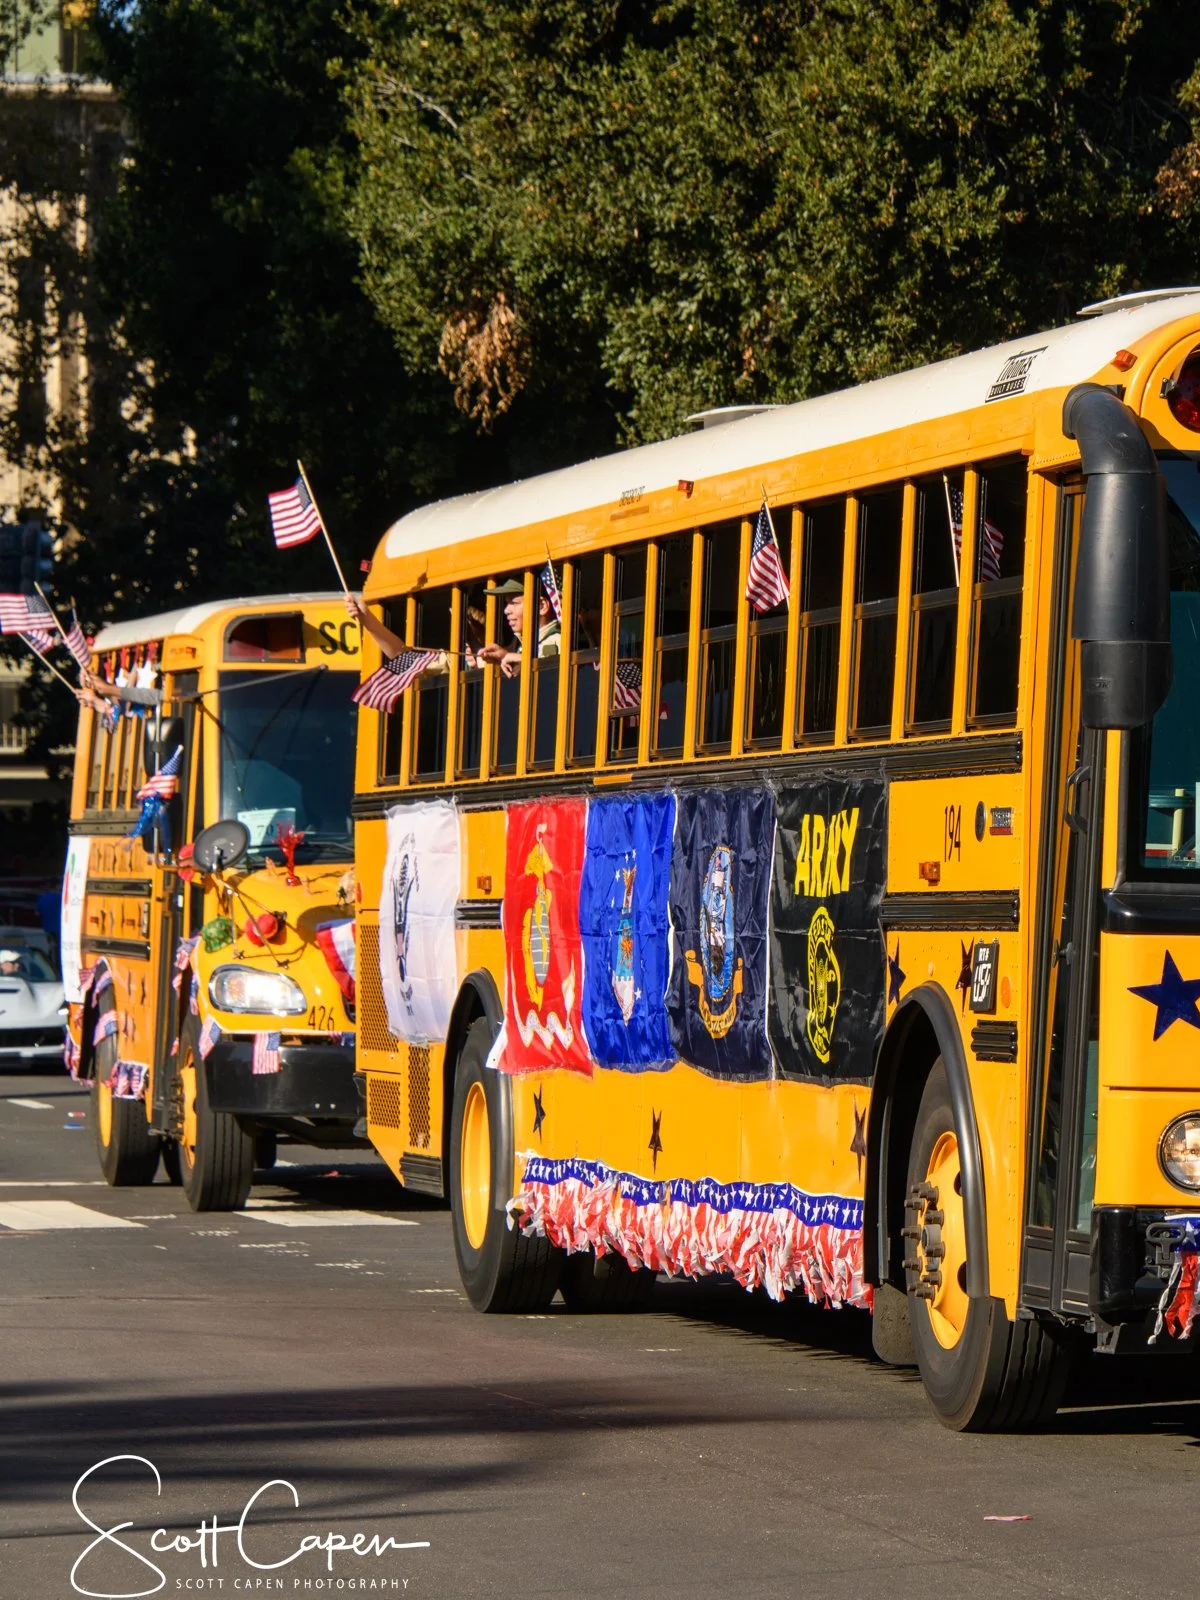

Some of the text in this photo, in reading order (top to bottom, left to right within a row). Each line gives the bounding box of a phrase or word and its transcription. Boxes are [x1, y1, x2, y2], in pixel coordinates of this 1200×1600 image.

[794, 808, 860, 897] ARMY
[944, 804, 961, 862] 194
[308, 1005, 335, 1031] 426
